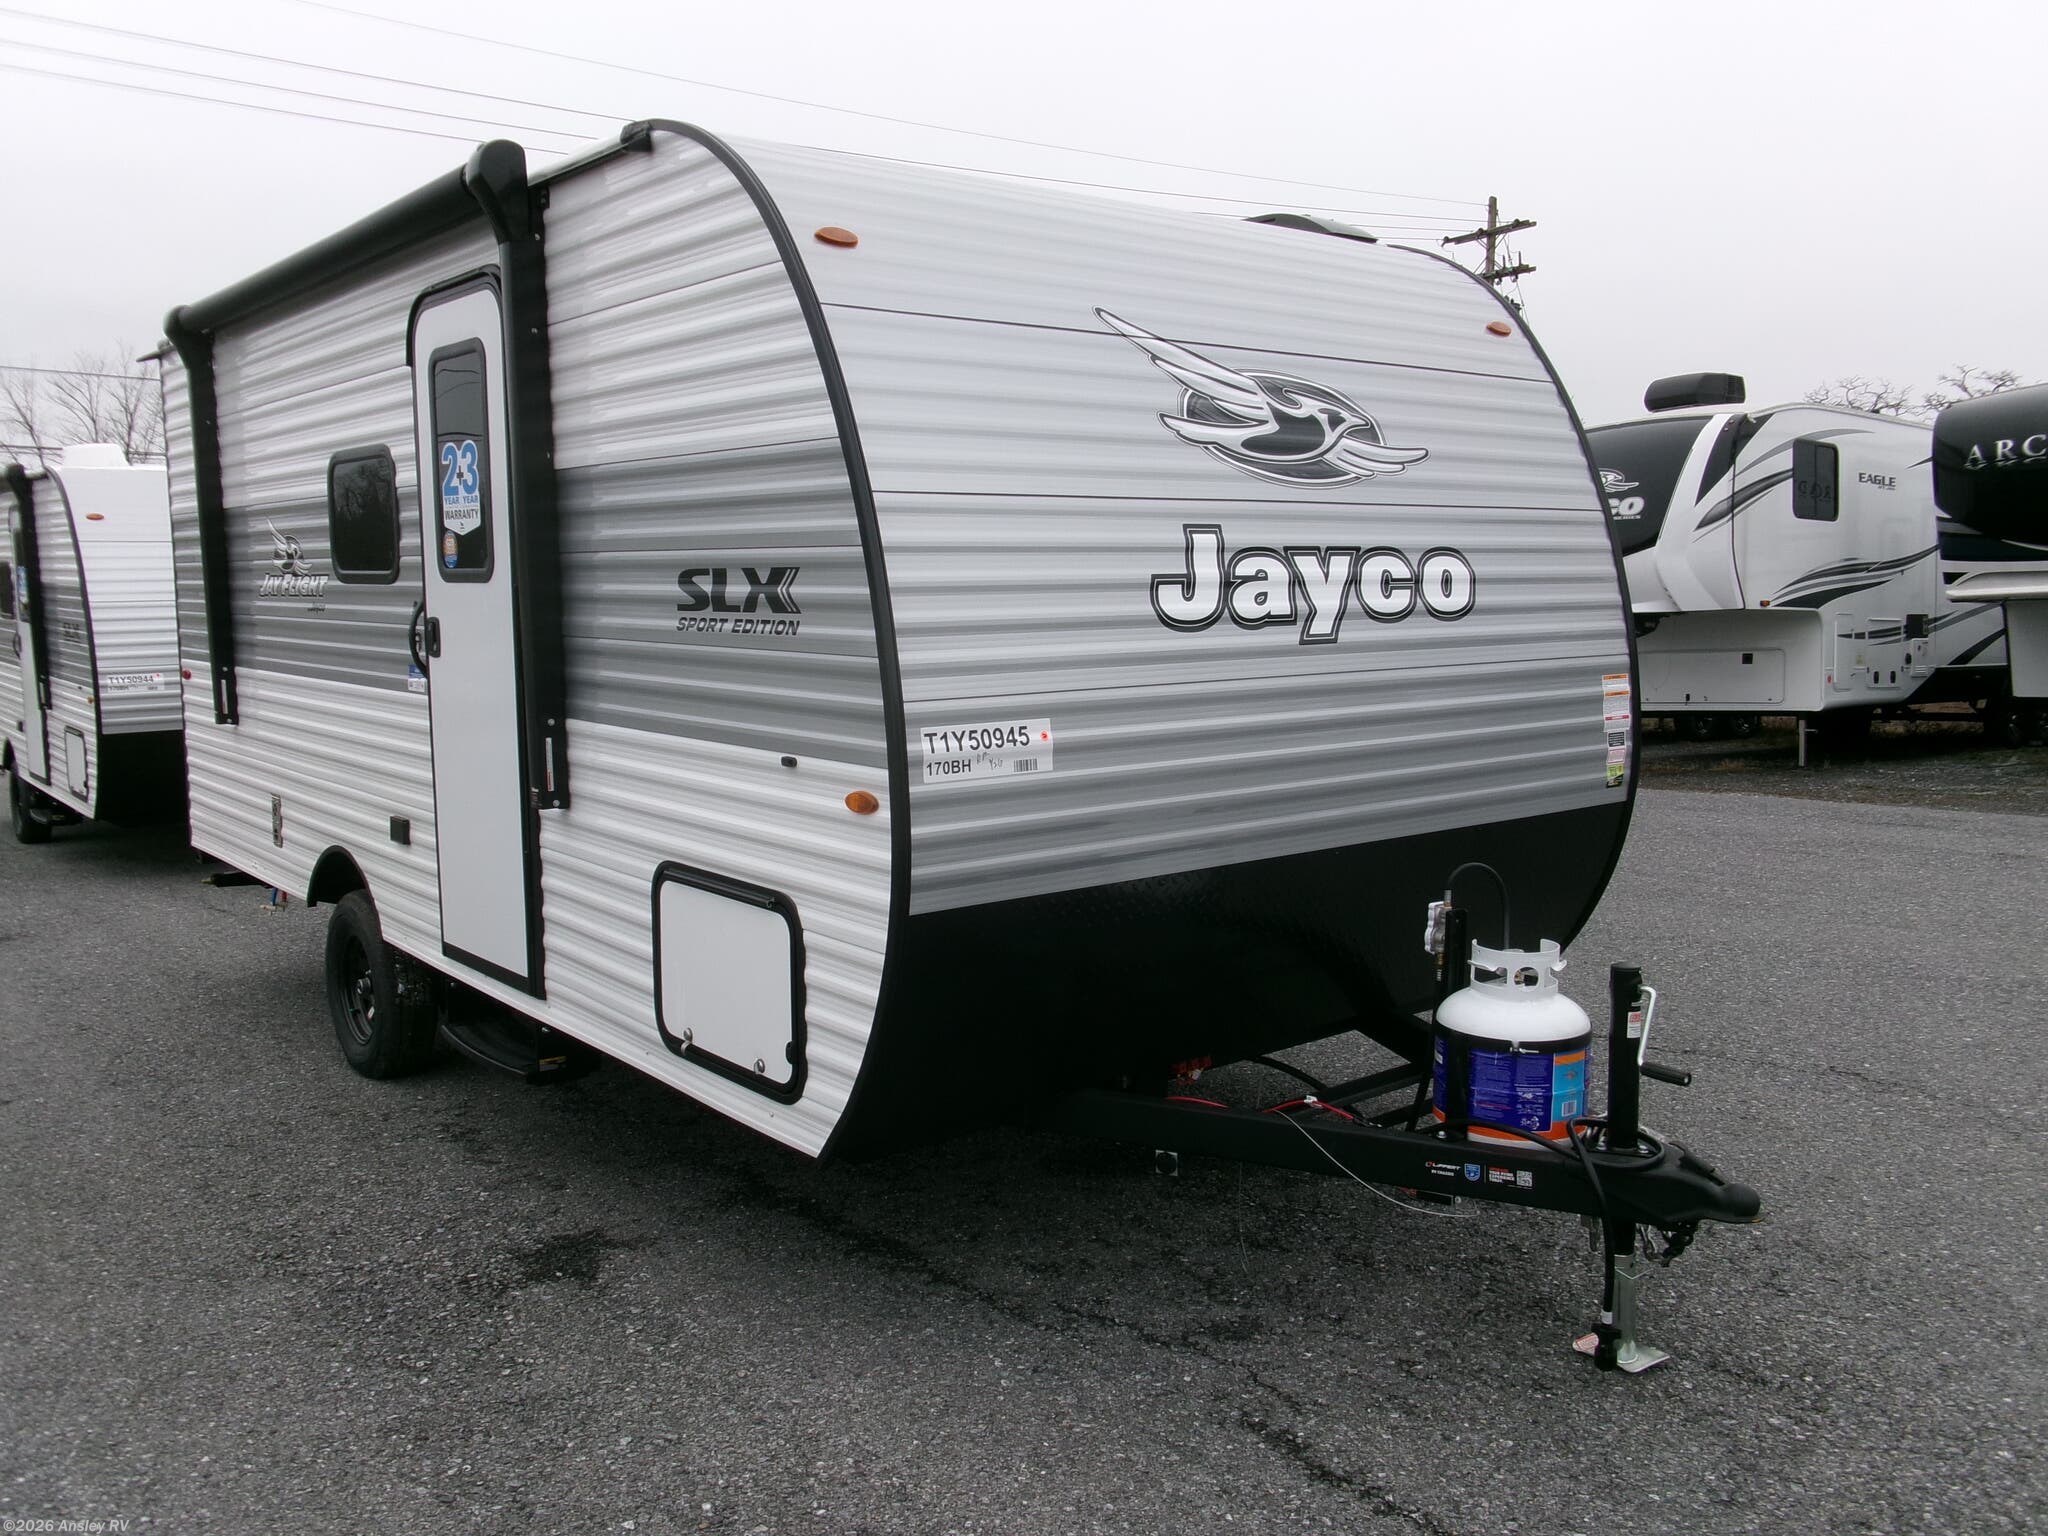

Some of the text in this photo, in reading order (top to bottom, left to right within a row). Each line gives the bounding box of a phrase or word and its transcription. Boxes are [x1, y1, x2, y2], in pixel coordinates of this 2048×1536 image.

[1858, 472, 1896, 487] EAGLE
[444, 494, 478, 506] YEAR YEAR
[445, 508, 479, 520] WARRANTY
[677, 567, 801, 614] SLX
[1150, 524, 1475, 646] Jayco
[676, 617, 800, 636] SPORT EDITION
[923, 725, 1030, 754] T1Y50945
[926, 759, 972, 776] 170BH
